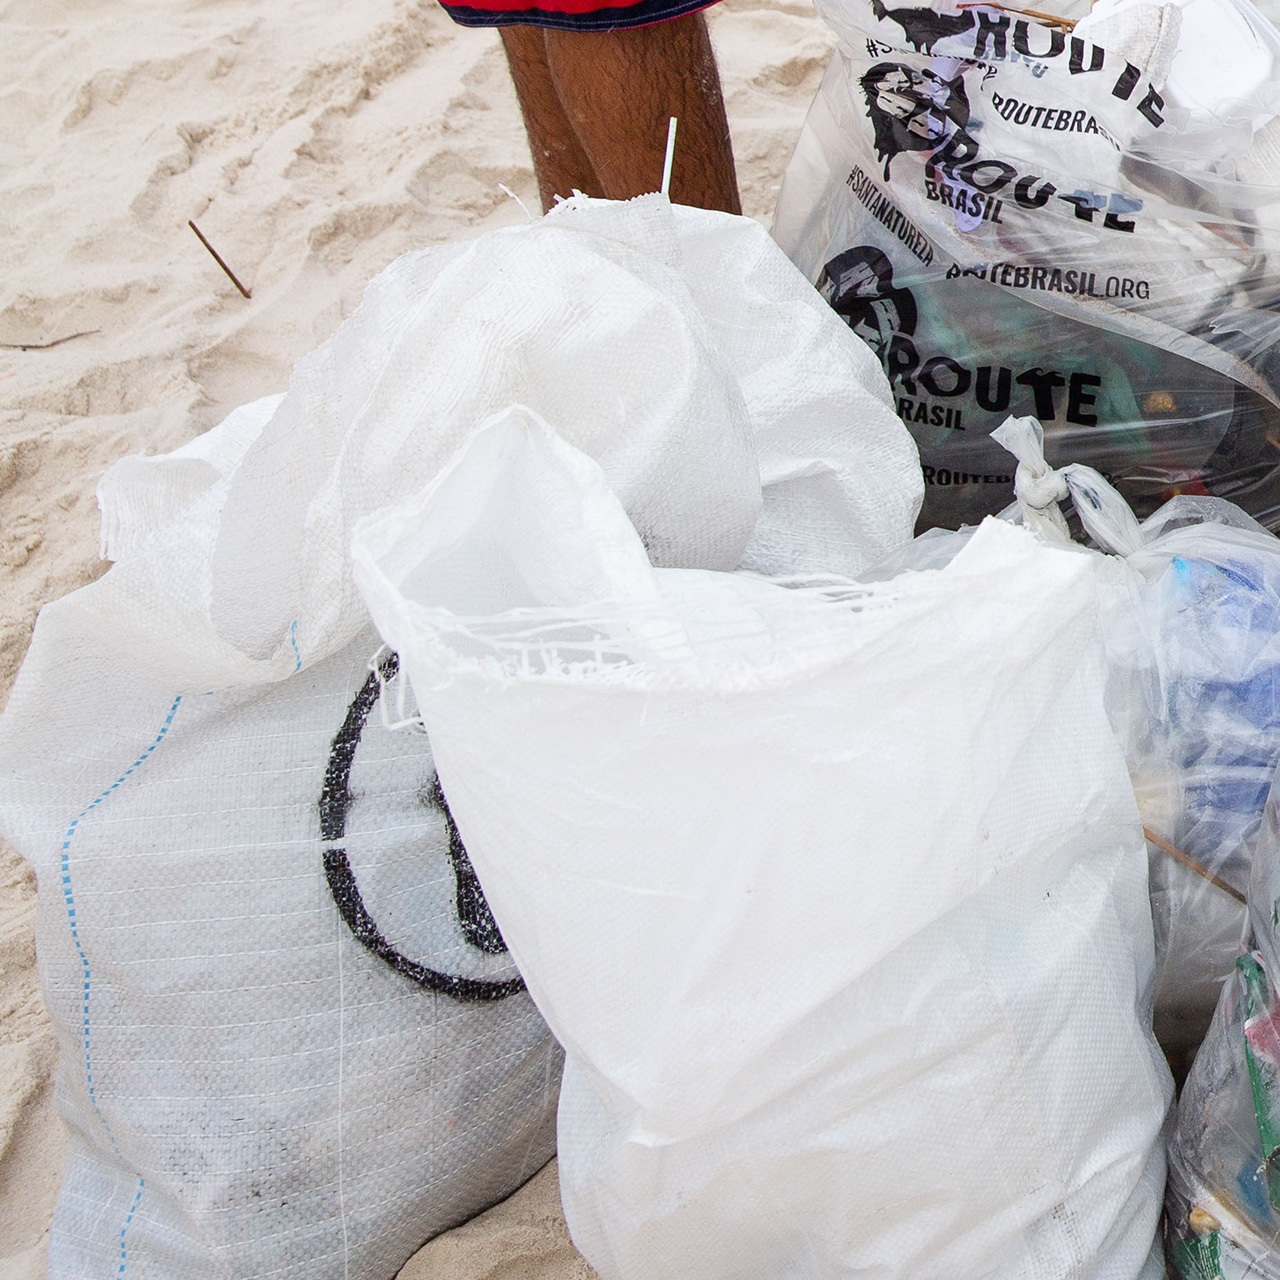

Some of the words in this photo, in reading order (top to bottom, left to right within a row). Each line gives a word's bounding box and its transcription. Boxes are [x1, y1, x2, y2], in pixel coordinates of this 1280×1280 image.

[846, 164, 935, 267] #SANTANATUREZA
[925, 179, 1003, 225] BRASIL
[887, 334, 1102, 428] ROUTE
[895, 396, 966, 431] RASIL
